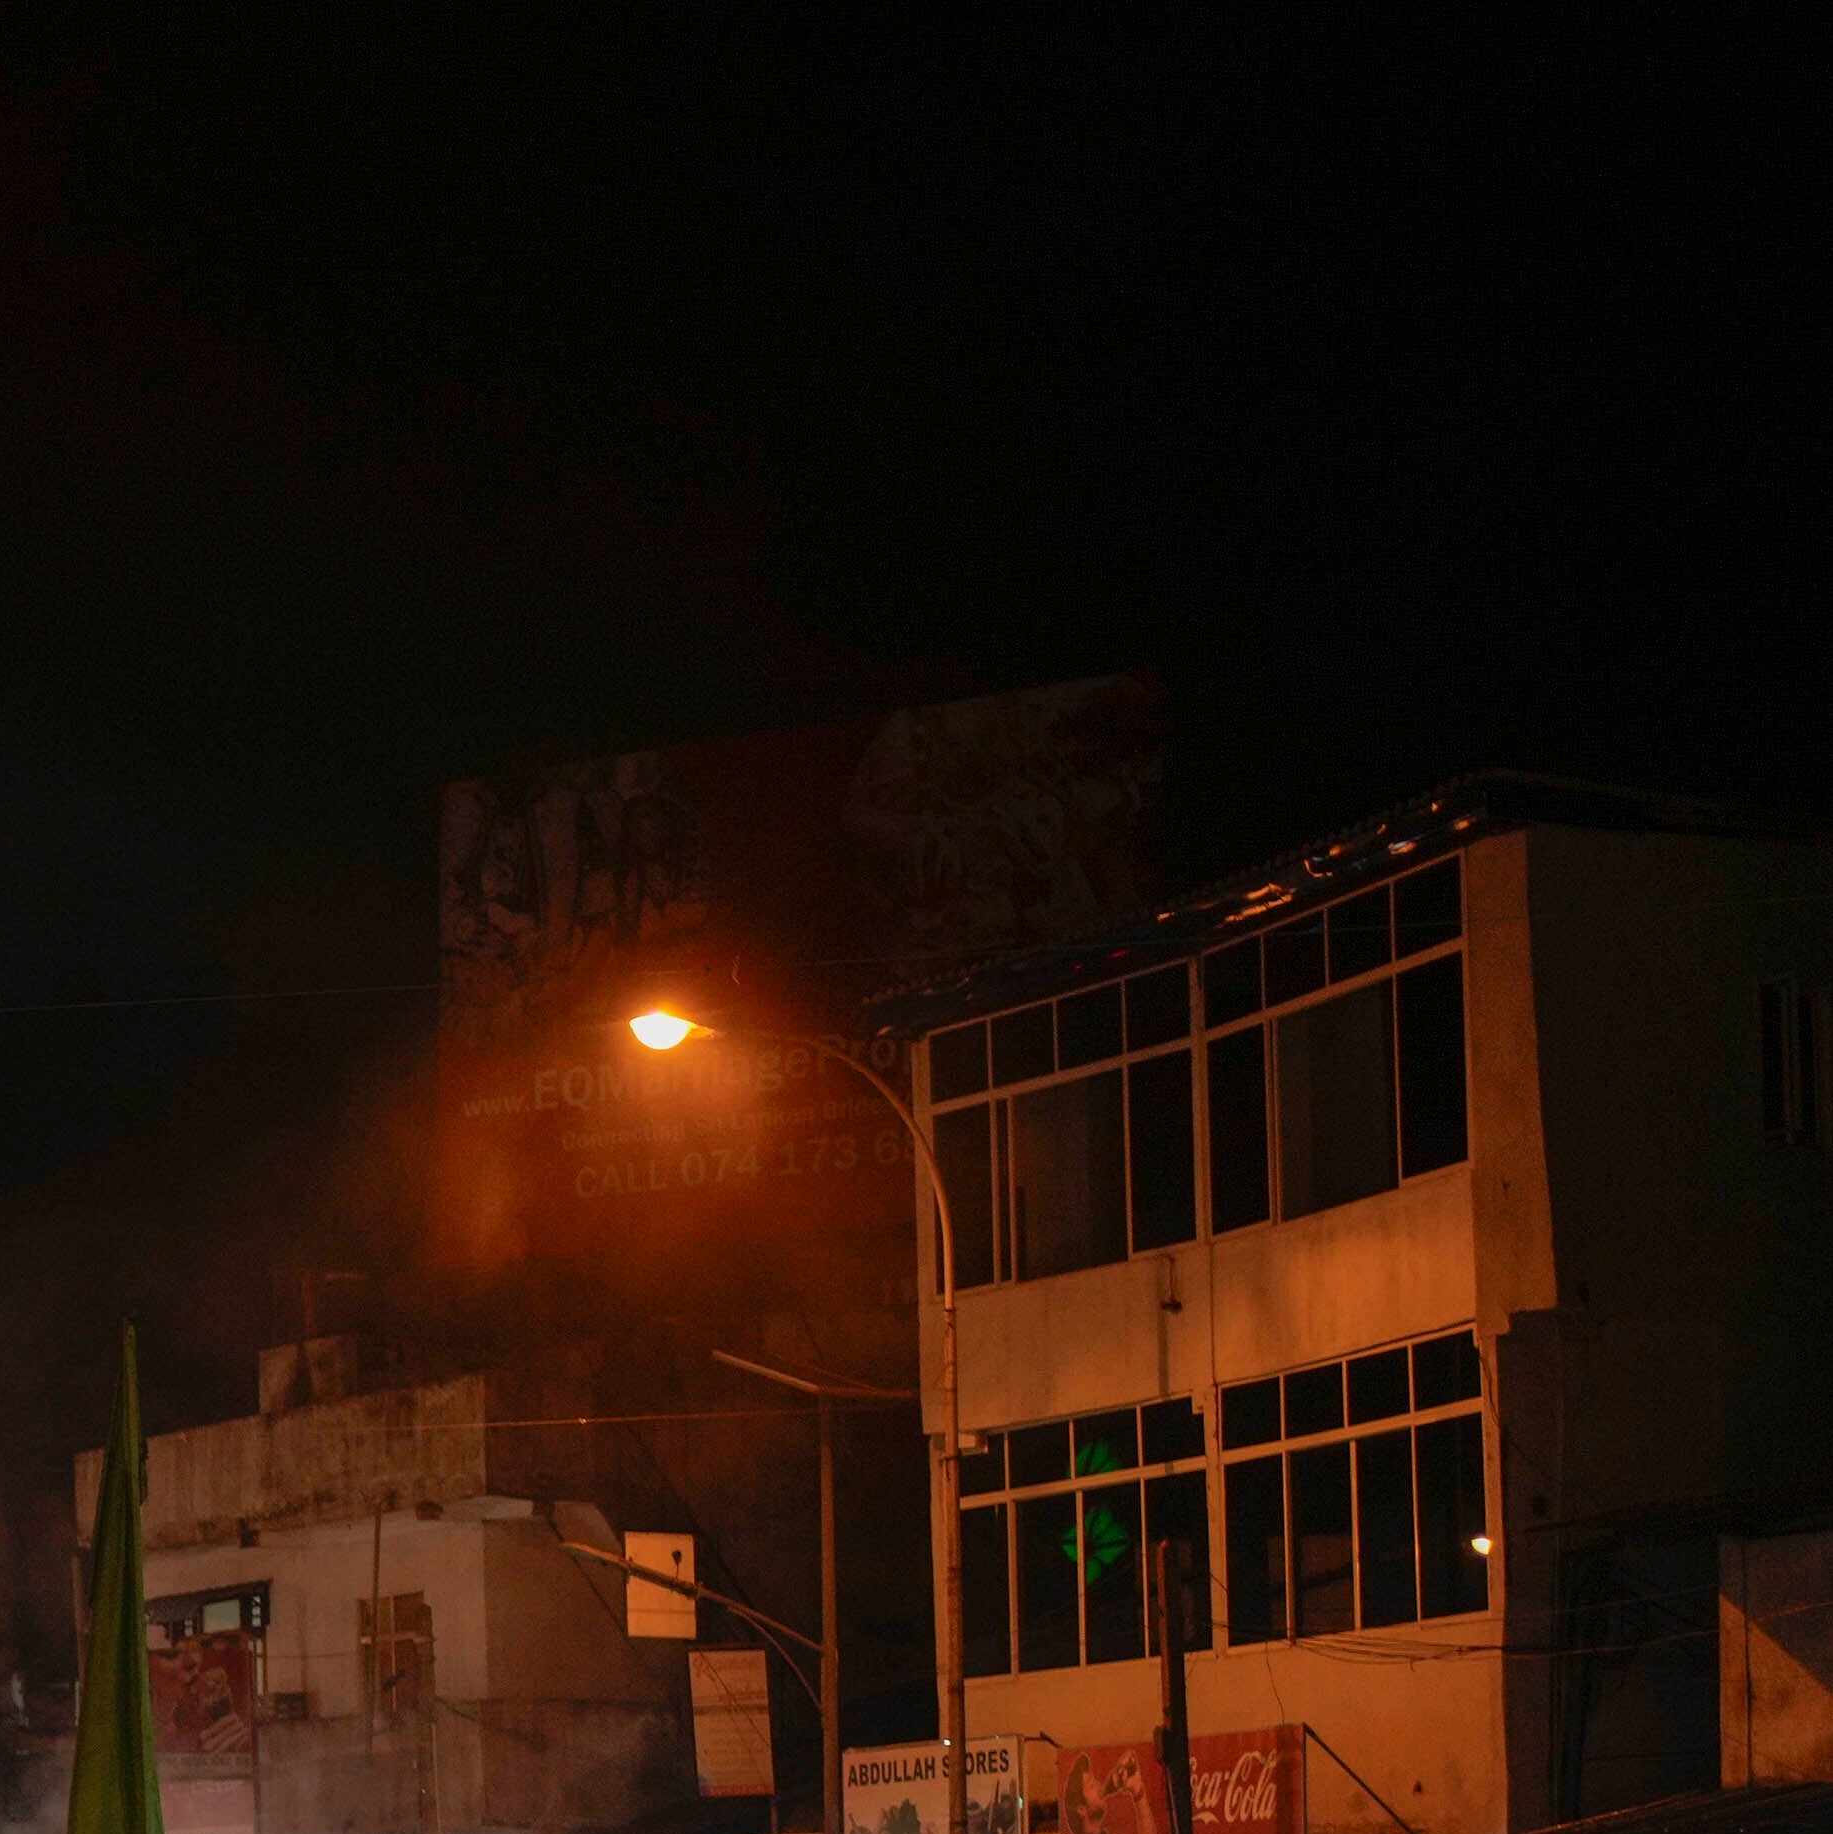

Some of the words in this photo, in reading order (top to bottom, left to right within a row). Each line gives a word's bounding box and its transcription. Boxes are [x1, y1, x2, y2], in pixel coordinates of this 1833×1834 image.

[575, 1160, 669, 1200] CALL
[679, 1144, 761, 1188] 074
[847, 1757, 936, 1788] ABDULLAH
[942, 1748, 1010, 1778] SORES
[1190, 1749, 1280, 1825] oca-Cola
